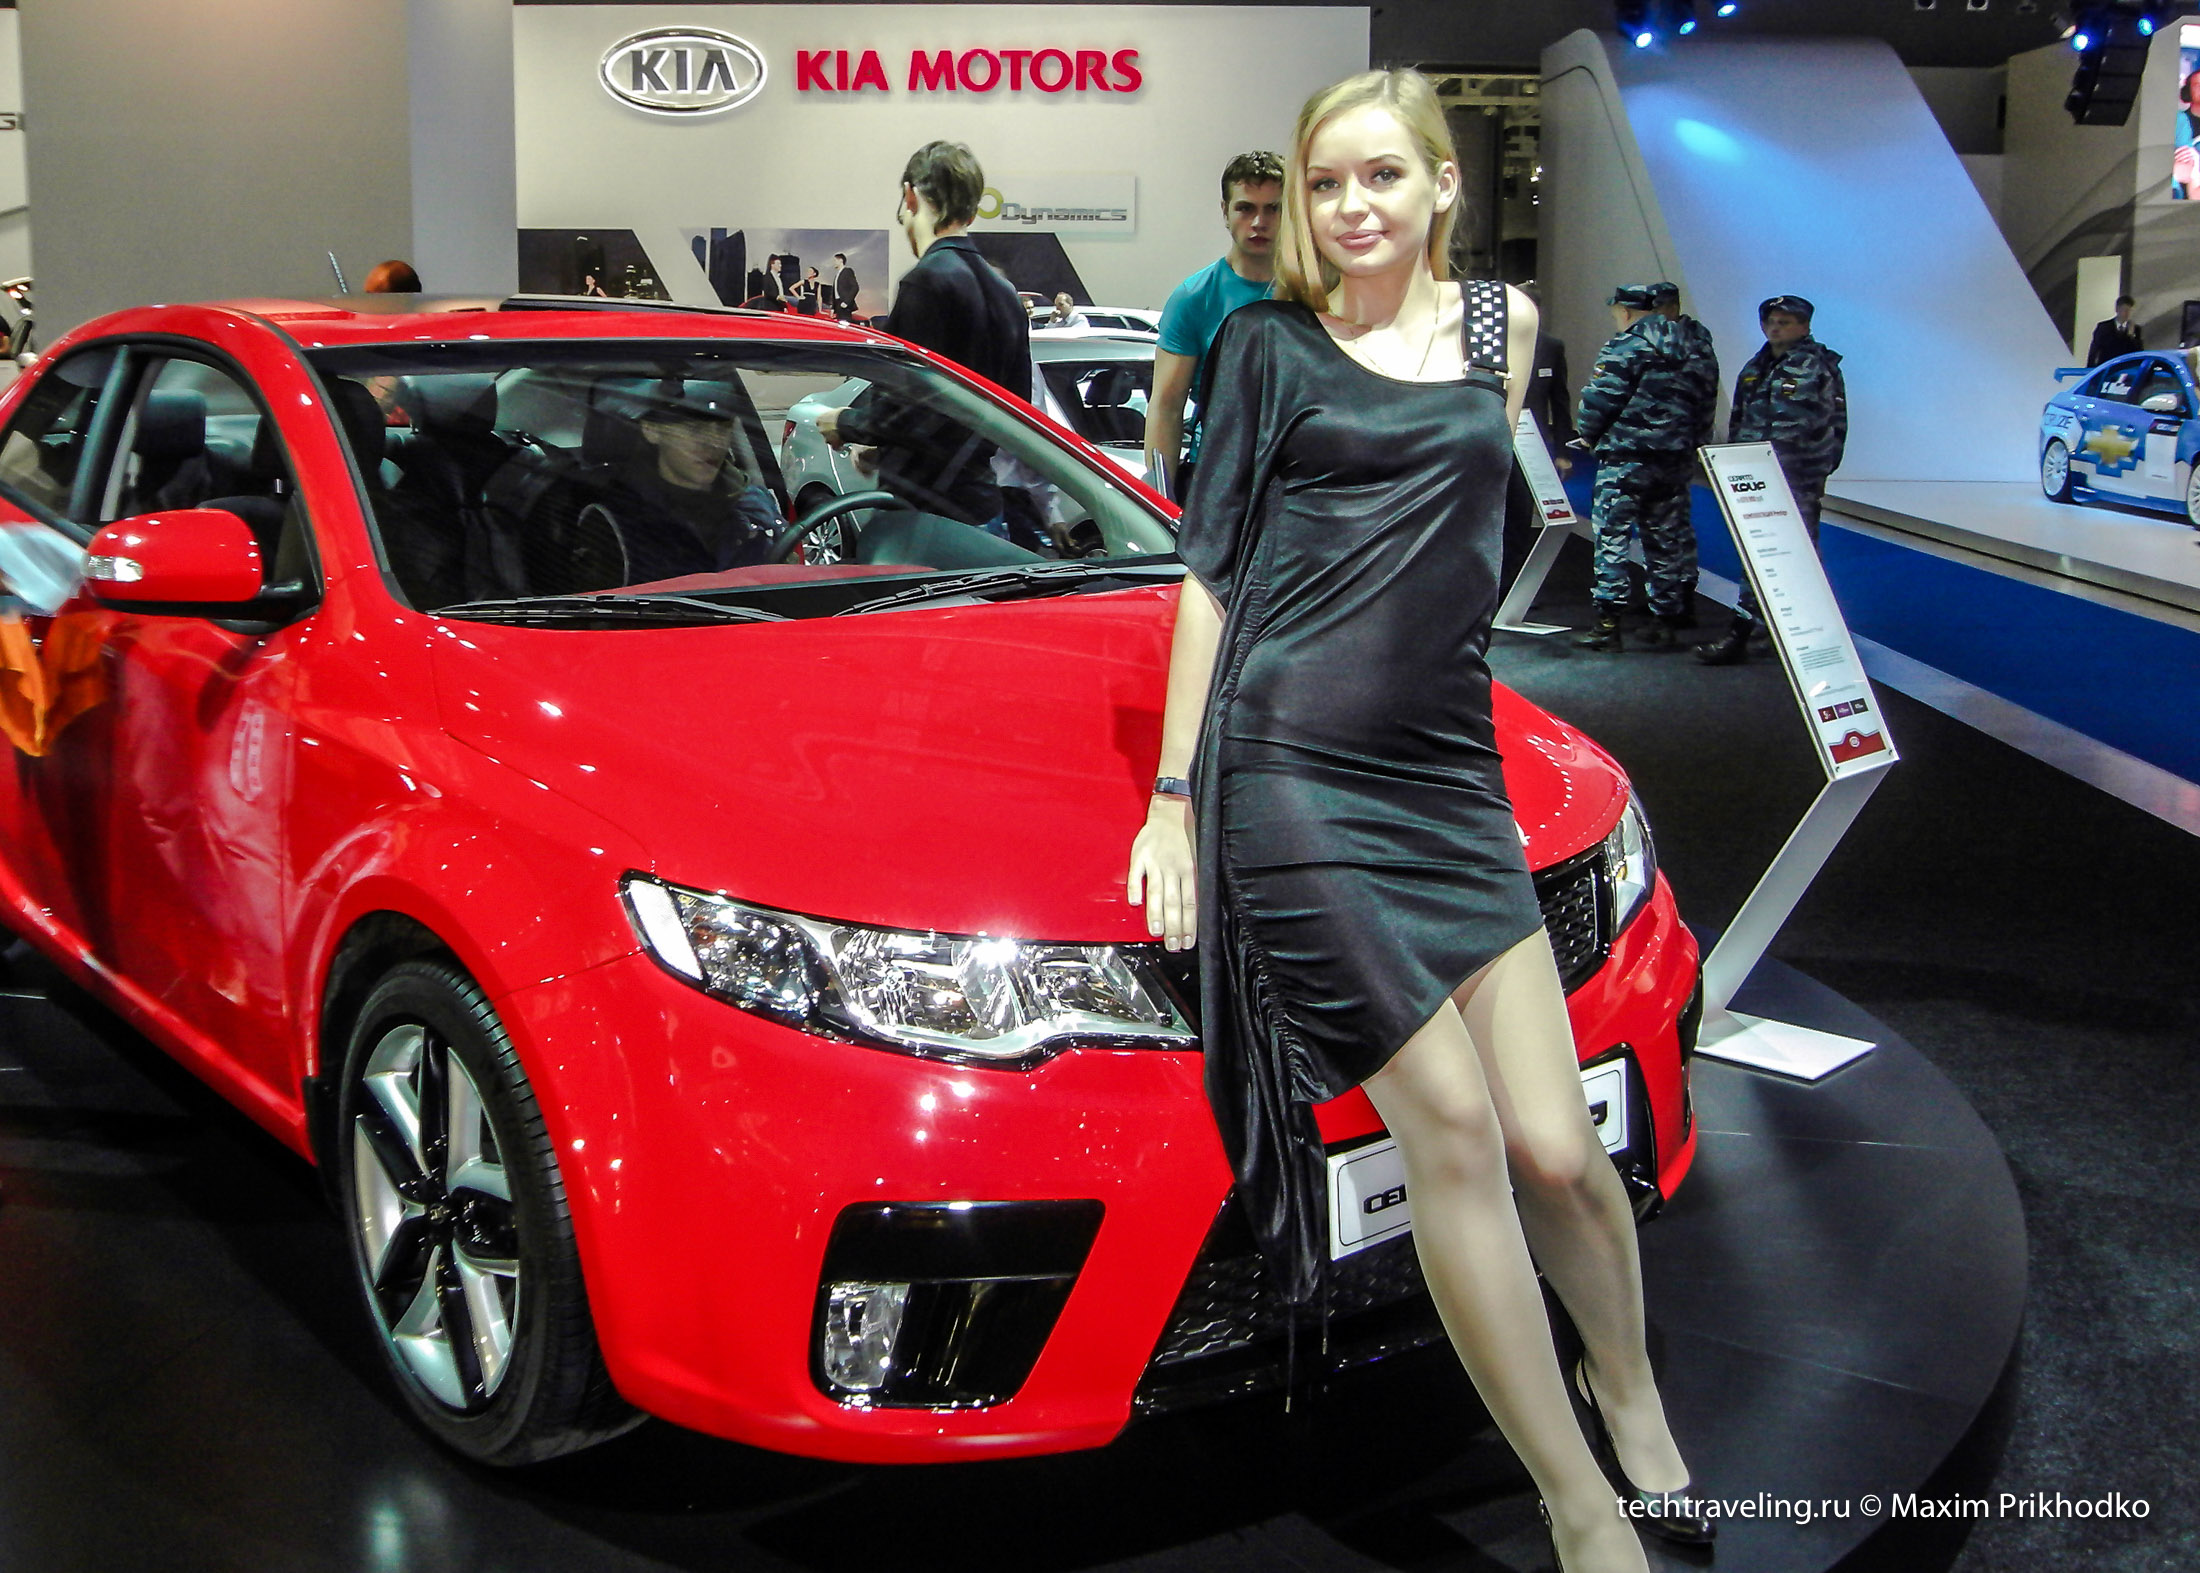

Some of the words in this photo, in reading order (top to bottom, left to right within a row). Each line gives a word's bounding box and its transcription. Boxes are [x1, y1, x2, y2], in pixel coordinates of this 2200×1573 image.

[631, 48, 739, 94] KIA
[796, 49, 890, 92] KIA
[907, 48, 1143, 93] MOTORS
